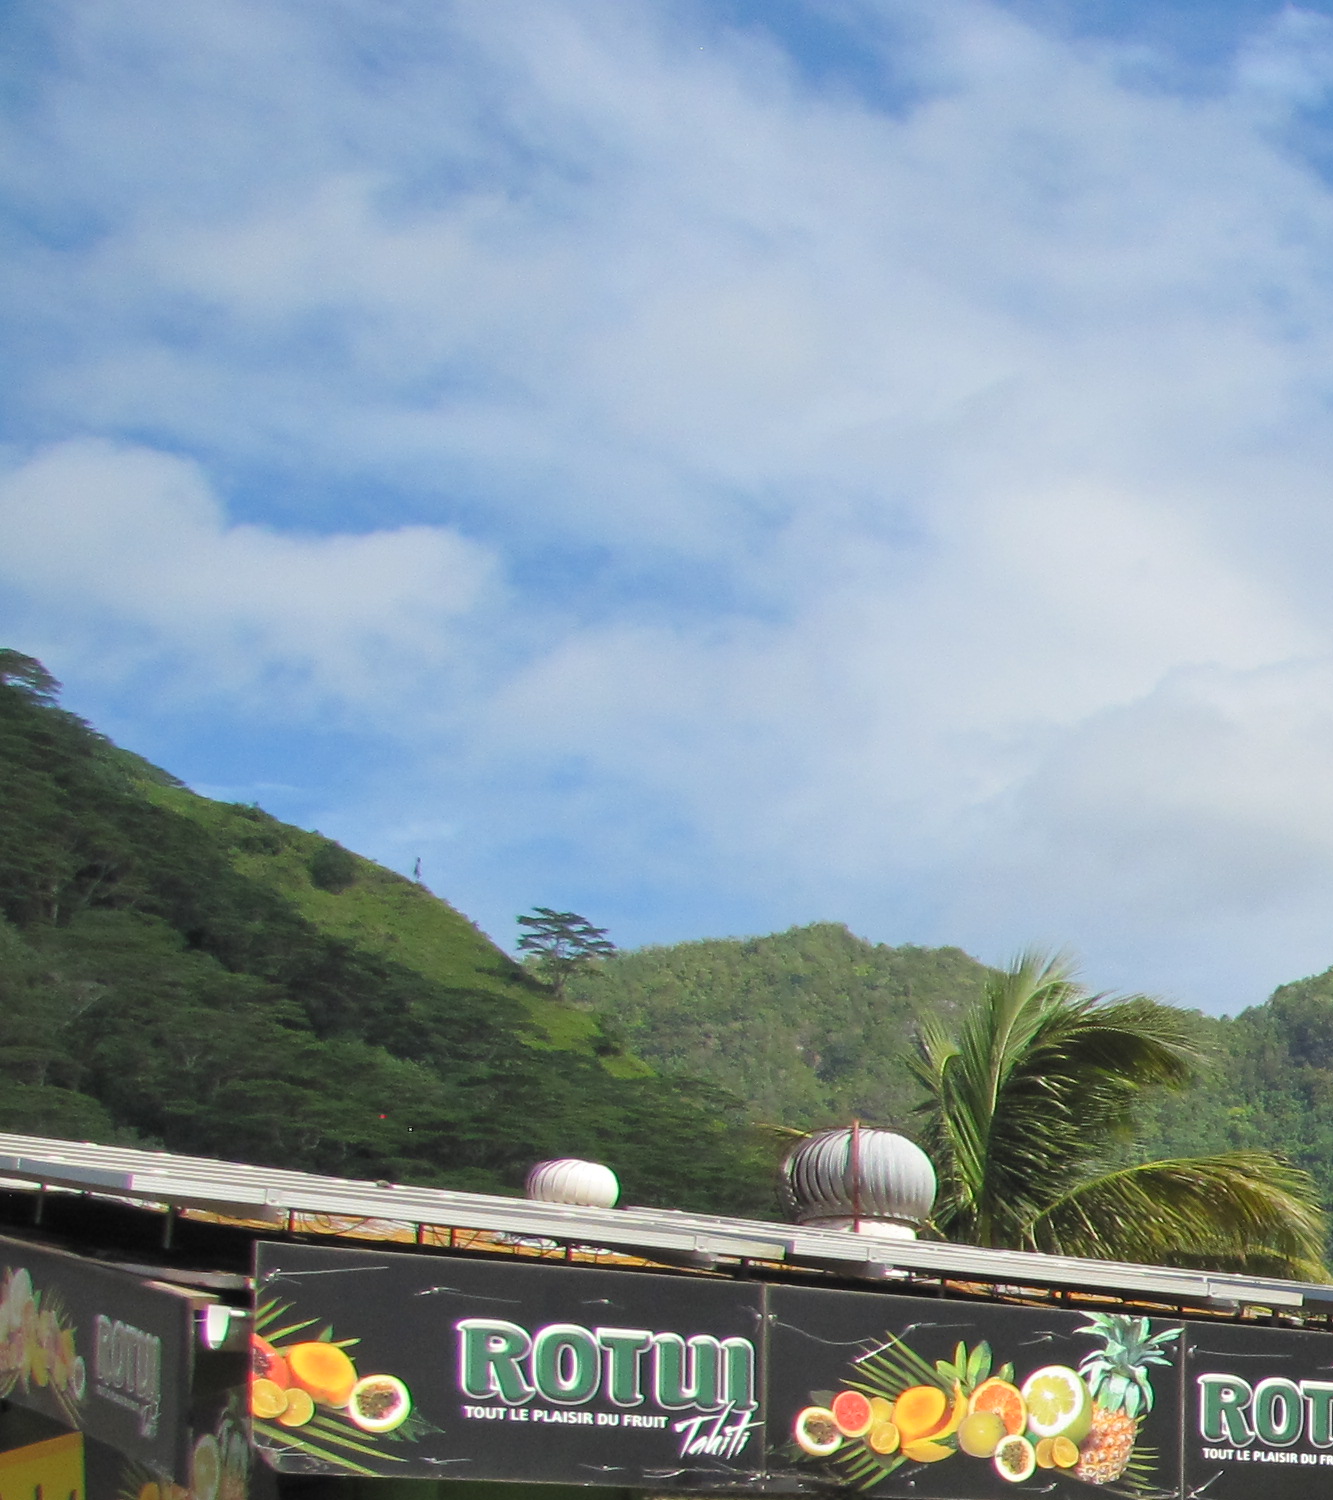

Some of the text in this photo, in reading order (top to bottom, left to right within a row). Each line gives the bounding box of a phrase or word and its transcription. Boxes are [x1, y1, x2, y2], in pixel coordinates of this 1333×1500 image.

[456, 1318, 758, 1413] ROTUI
[464, 1405, 669, 1429] TOUT LE PLAISIR DU FRUIT
[674, 1401, 765, 1459] Tahiti
[1203, 1448, 1233, 1460] TOUT
[1236, 1449, 1250, 1462] LE
[1253, 1451, 1298, 1464] PLAISIR
[1301, 1453, 1317, 1465] DU
